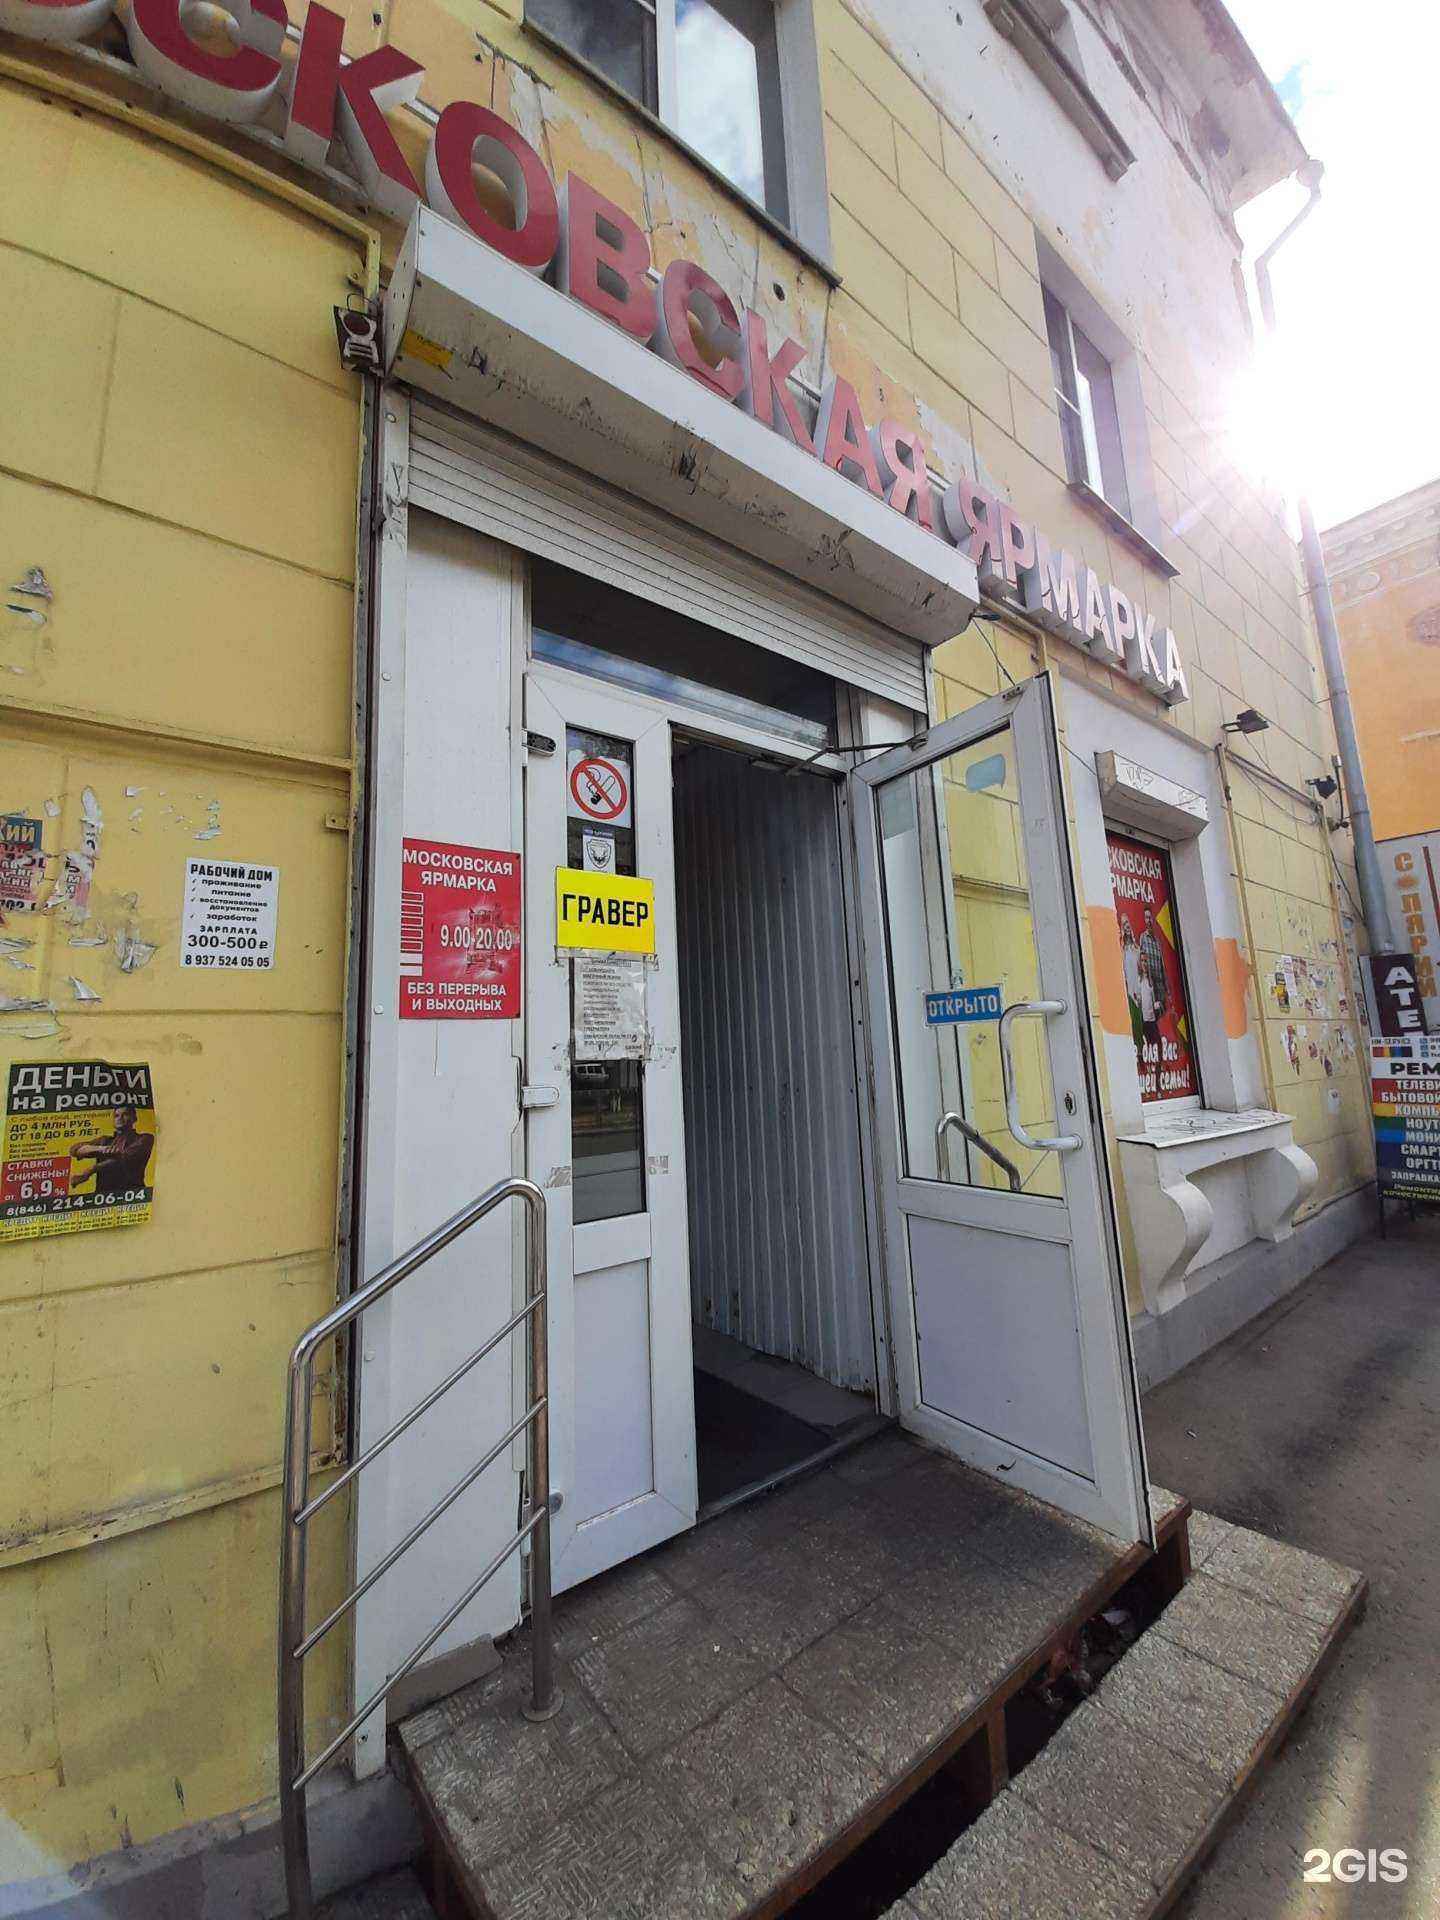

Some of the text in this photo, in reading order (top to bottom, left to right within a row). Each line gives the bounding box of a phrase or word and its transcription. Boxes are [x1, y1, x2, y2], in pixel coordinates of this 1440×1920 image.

[0, 0, 1190, 702] СКОВСКАЯ ЯРМАРКА
[403, 848, 513, 875] МОСКОВСКАЯ
[190, 863, 273, 881] РАБОЧИЙ ДОМ
[201, 879, 262, 889] проживание
[421, 871, 497, 892] ЯРМАРКА
[211, 889, 251, 898] питание
[200, 897, 268, 907] восстановление
[206, 913, 257, 922] заработок
[562, 893, 649, 928] ГРАВЕР
[199, 925, 258, 935] ЗАРПЛАТА
[187, 934, 257, 949] 300-500
[185, 954, 270, 967] 8 937 524 05 05
[407, 982, 507, 996] БЕЗ ПЕРЕРЫВА
[412, 998, 502, 1013] И ВЫХОДНЫХ
[928, 994, 998, 1017] ОТКРЫТО
[12, 1066, 147, 1095] ДЕНЬГИ
[12, 1091, 149, 1112] на ремонт
[10, 1123, 28, 1133] ДО
[10, 1132, 26, 1141] ОТ
[44, 1130, 61, 1140] ДО
[7, 1159, 53, 1171] СТАВКИ
[6, 1169, 69, 1182] СНИЖЕНЫ!
[20, 1179, 53, 1201] 6,9
[6, 1189, 146, 1216] 8(846) 214-06-04
